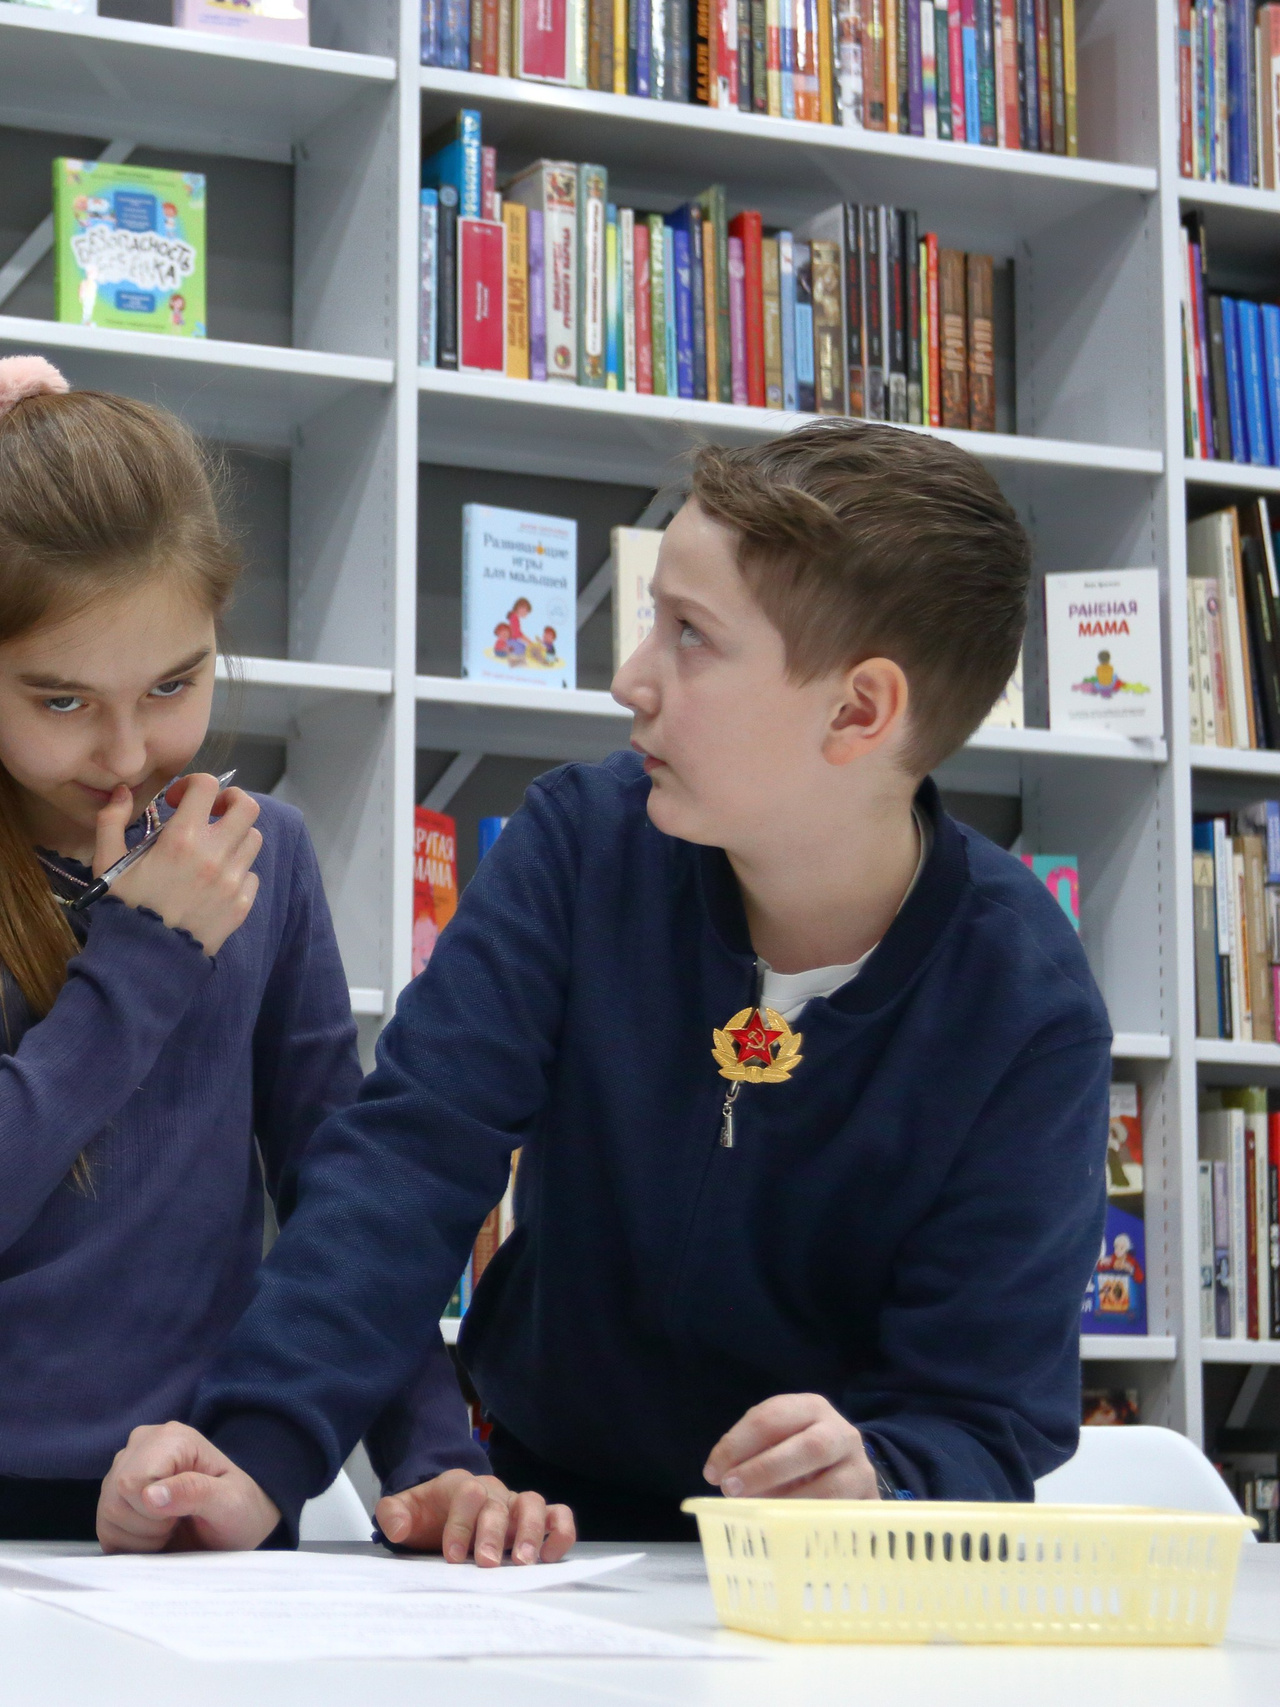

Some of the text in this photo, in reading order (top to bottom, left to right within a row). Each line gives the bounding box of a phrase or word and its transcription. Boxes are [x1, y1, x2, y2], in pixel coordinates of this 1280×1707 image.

[511, 555, 544, 571] игры
[483, 566, 568, 589] для малышей
[1068, 600, 1138, 619] РАНЕНАЯ
[1078, 619, 1130, 637] МАМА
